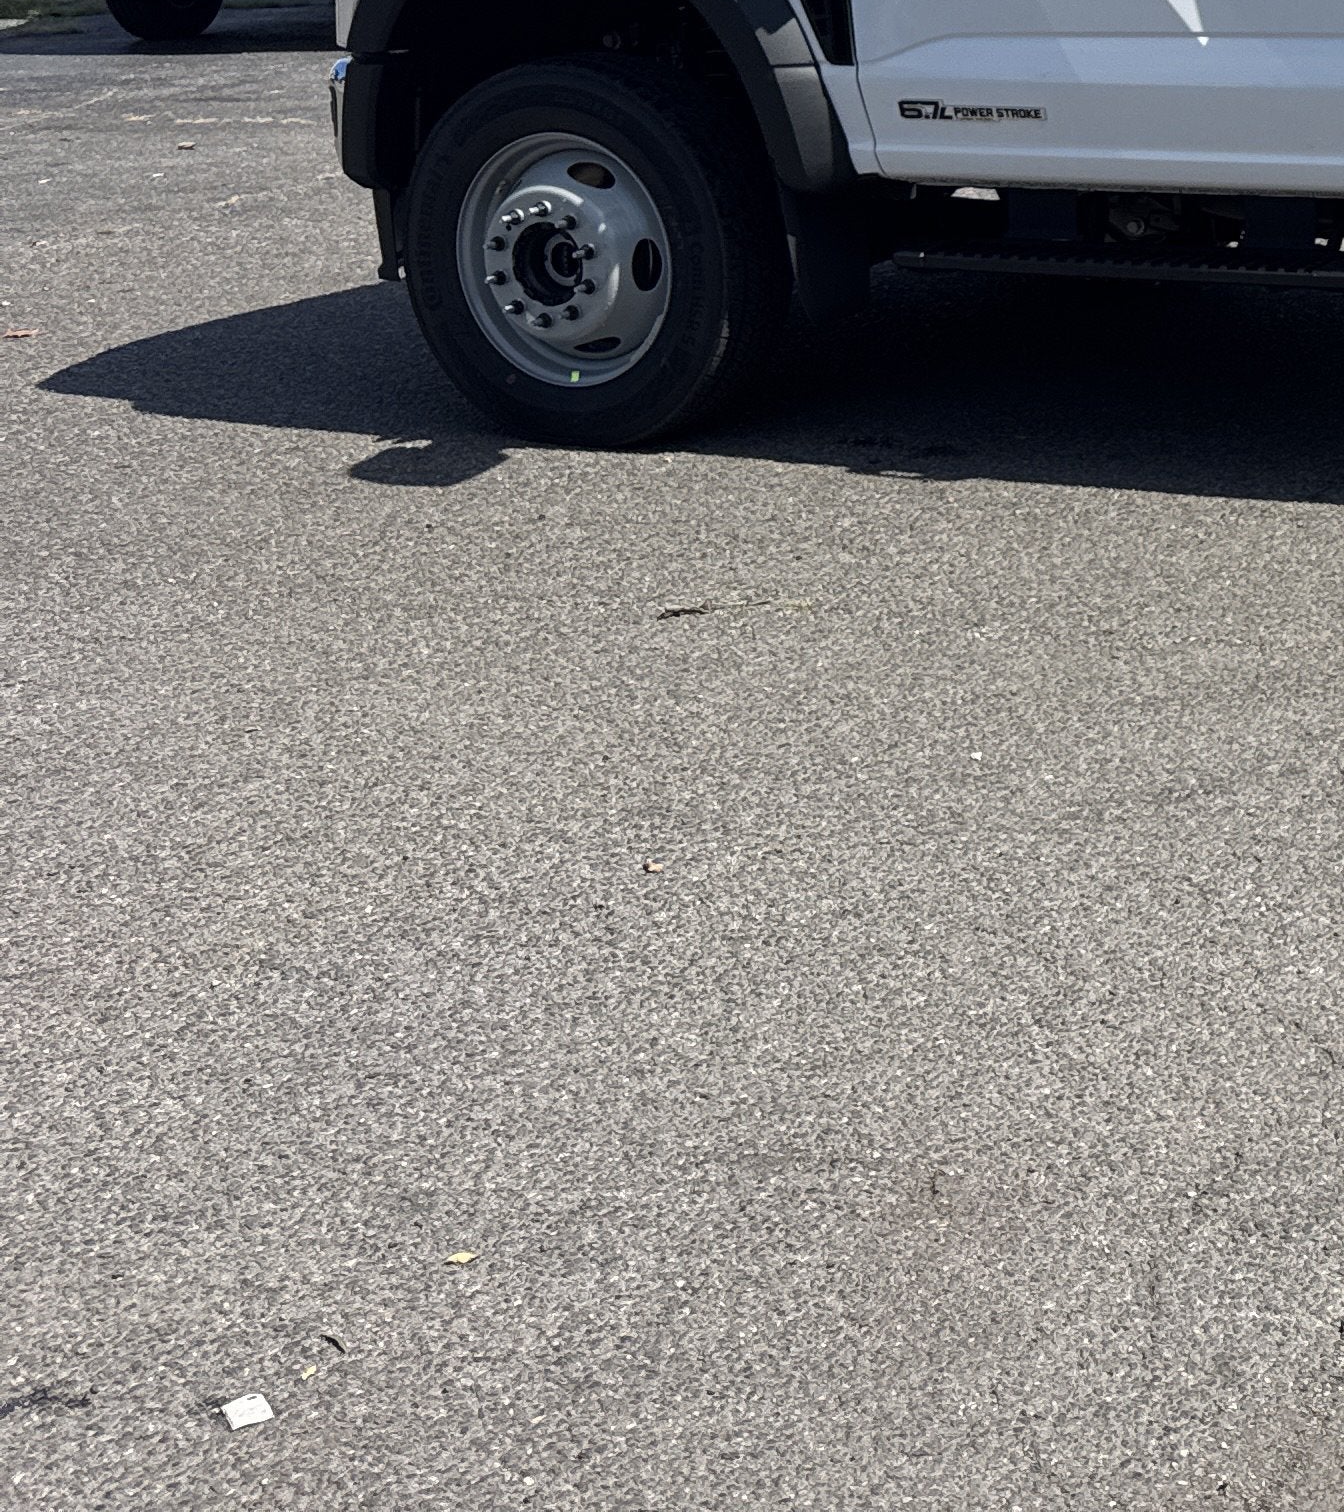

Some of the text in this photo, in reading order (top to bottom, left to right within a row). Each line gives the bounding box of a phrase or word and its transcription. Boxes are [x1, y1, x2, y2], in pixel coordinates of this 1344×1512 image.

[898, 100, 1042, 120] 6.7L POWER STROKE
